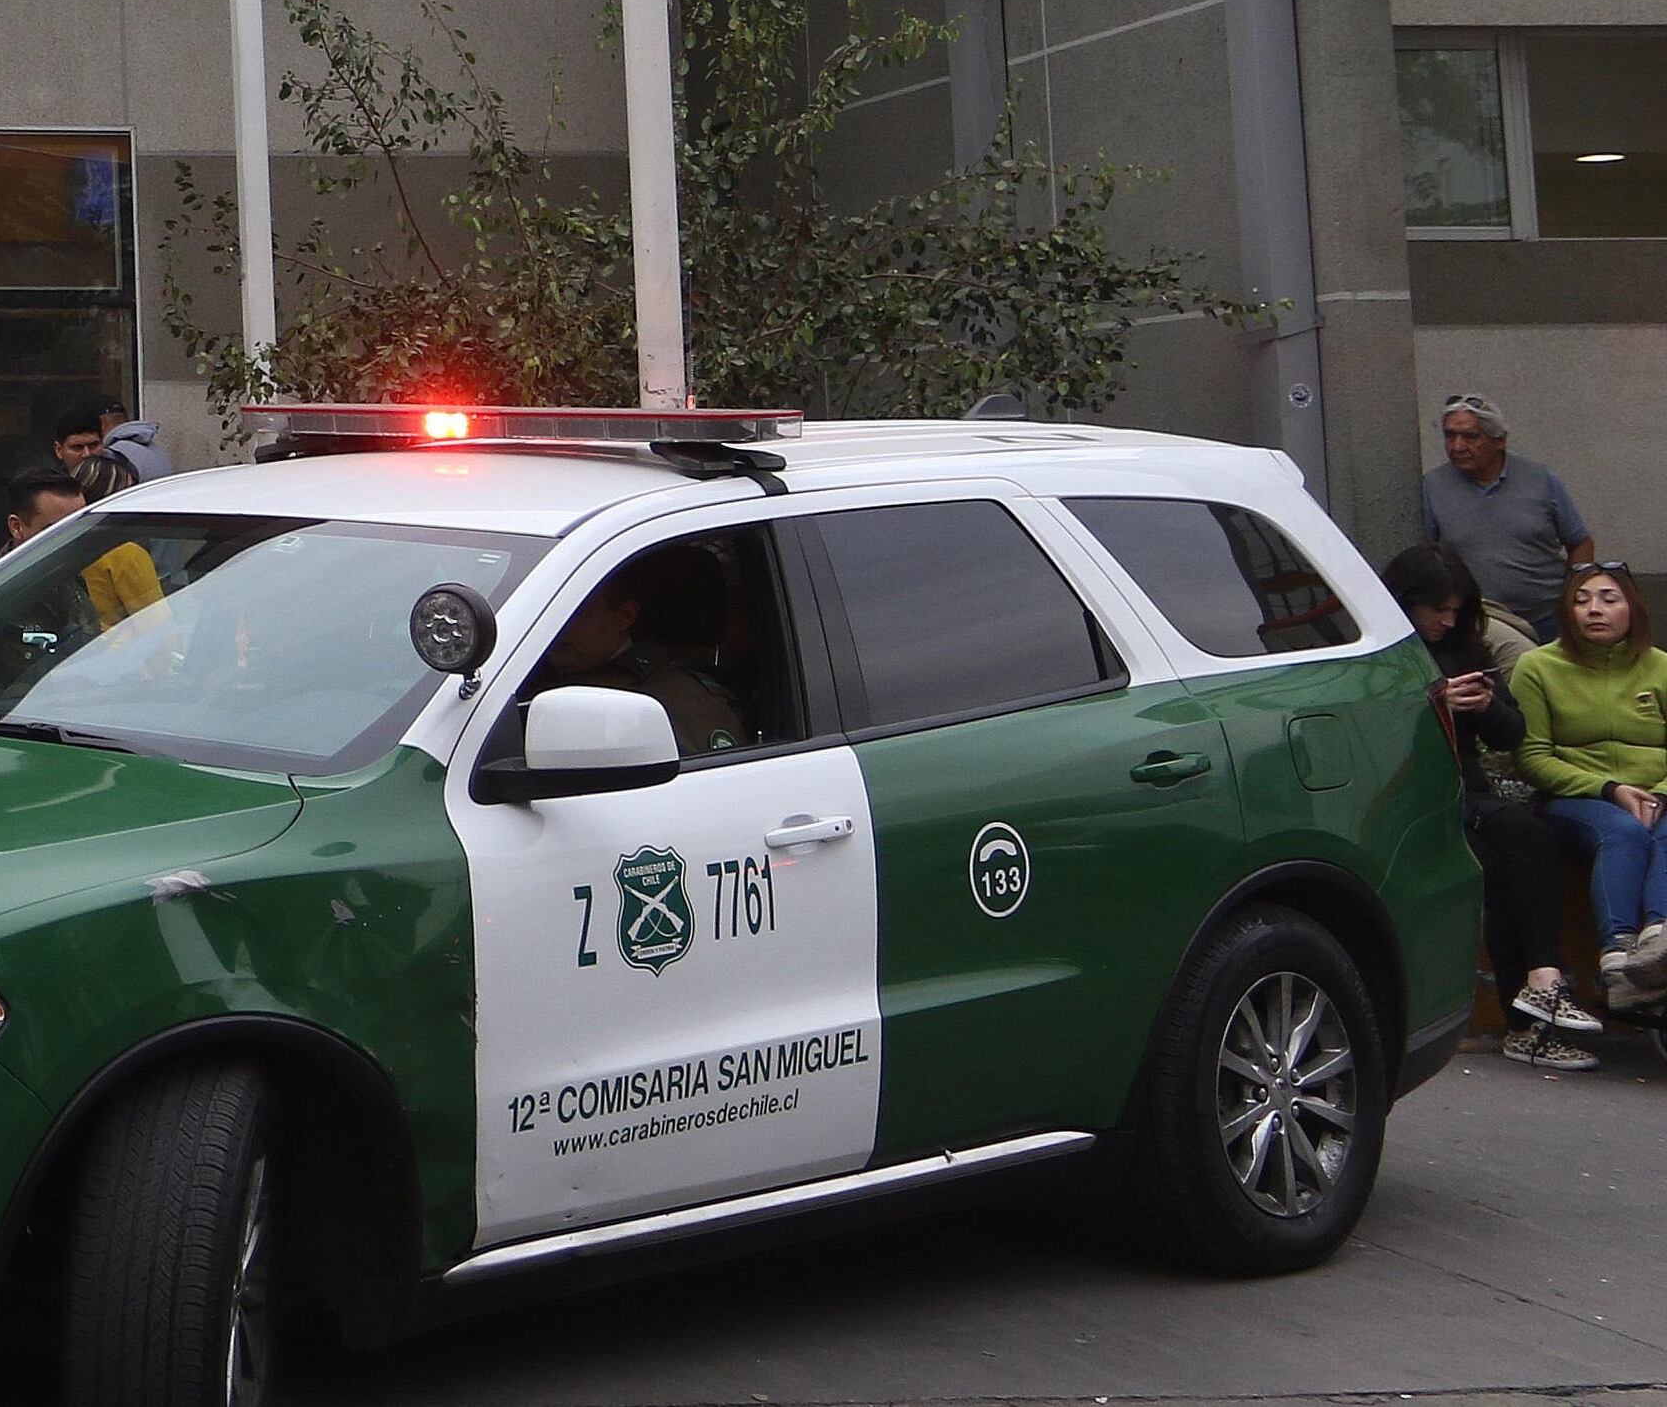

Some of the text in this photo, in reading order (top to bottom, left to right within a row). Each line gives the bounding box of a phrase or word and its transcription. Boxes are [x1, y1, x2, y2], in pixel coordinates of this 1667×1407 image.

[573, 855, 775, 968] Z 7761
[642, 874, 661, 886] CHILE
[981, 866, 1021, 897] 133
[557, 1060, 709, 1123] COMISARIA
[717, 1047, 773, 1091] SAN
[776, 1029, 869, 1078] MIGUEL
[553, 1088, 799, 1157] www.carabinerosdechile.cl
